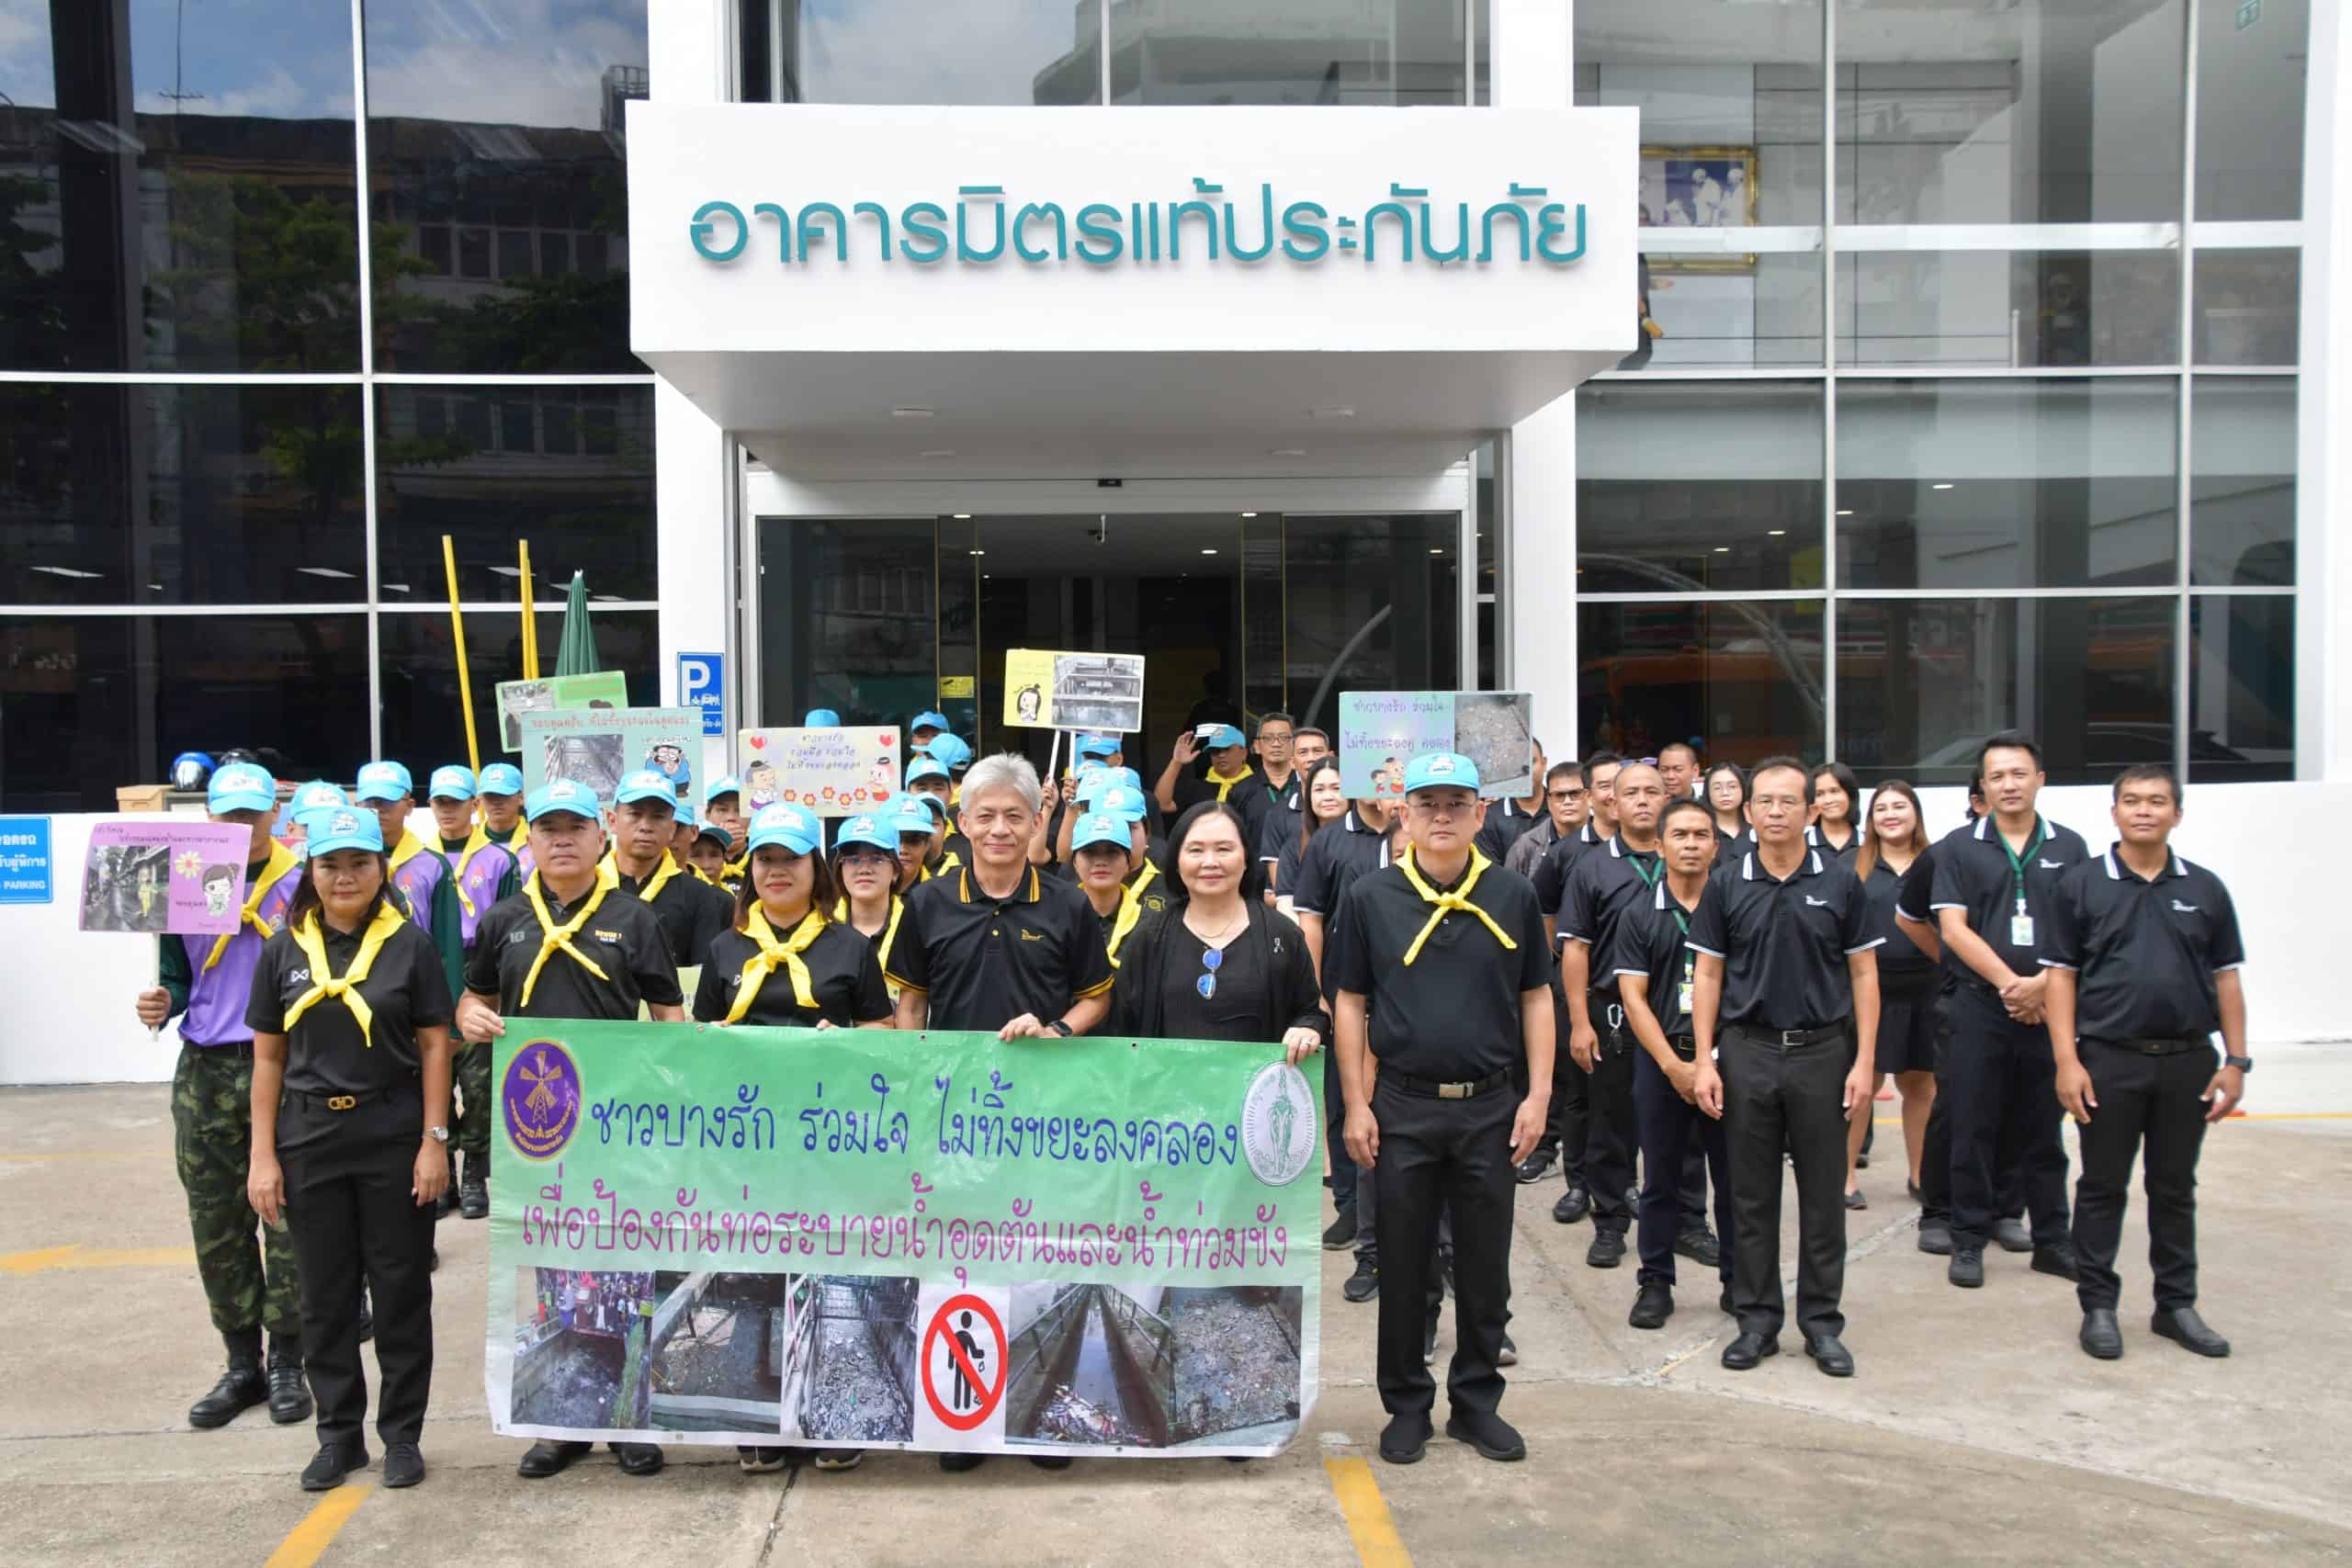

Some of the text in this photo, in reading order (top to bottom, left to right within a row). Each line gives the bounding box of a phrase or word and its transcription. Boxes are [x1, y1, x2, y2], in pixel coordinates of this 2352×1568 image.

[691, 178, 1585, 264] อาคารมิตรแท้ประกันภัย
[4, 880, 46, 890] PARKING
[591, 1084, 775, 1150] ชาวบางรัก
[799, 1073, 909, 1154] ร่วมใจ
[934, 1070, 1238, 1167] ไม่ทิ้งขยะลงคลอง
[522, 1162, 1288, 1289] เพื่อป้องกันท่อระบายน้ำอุดตันและน้ำท่วมขัง
